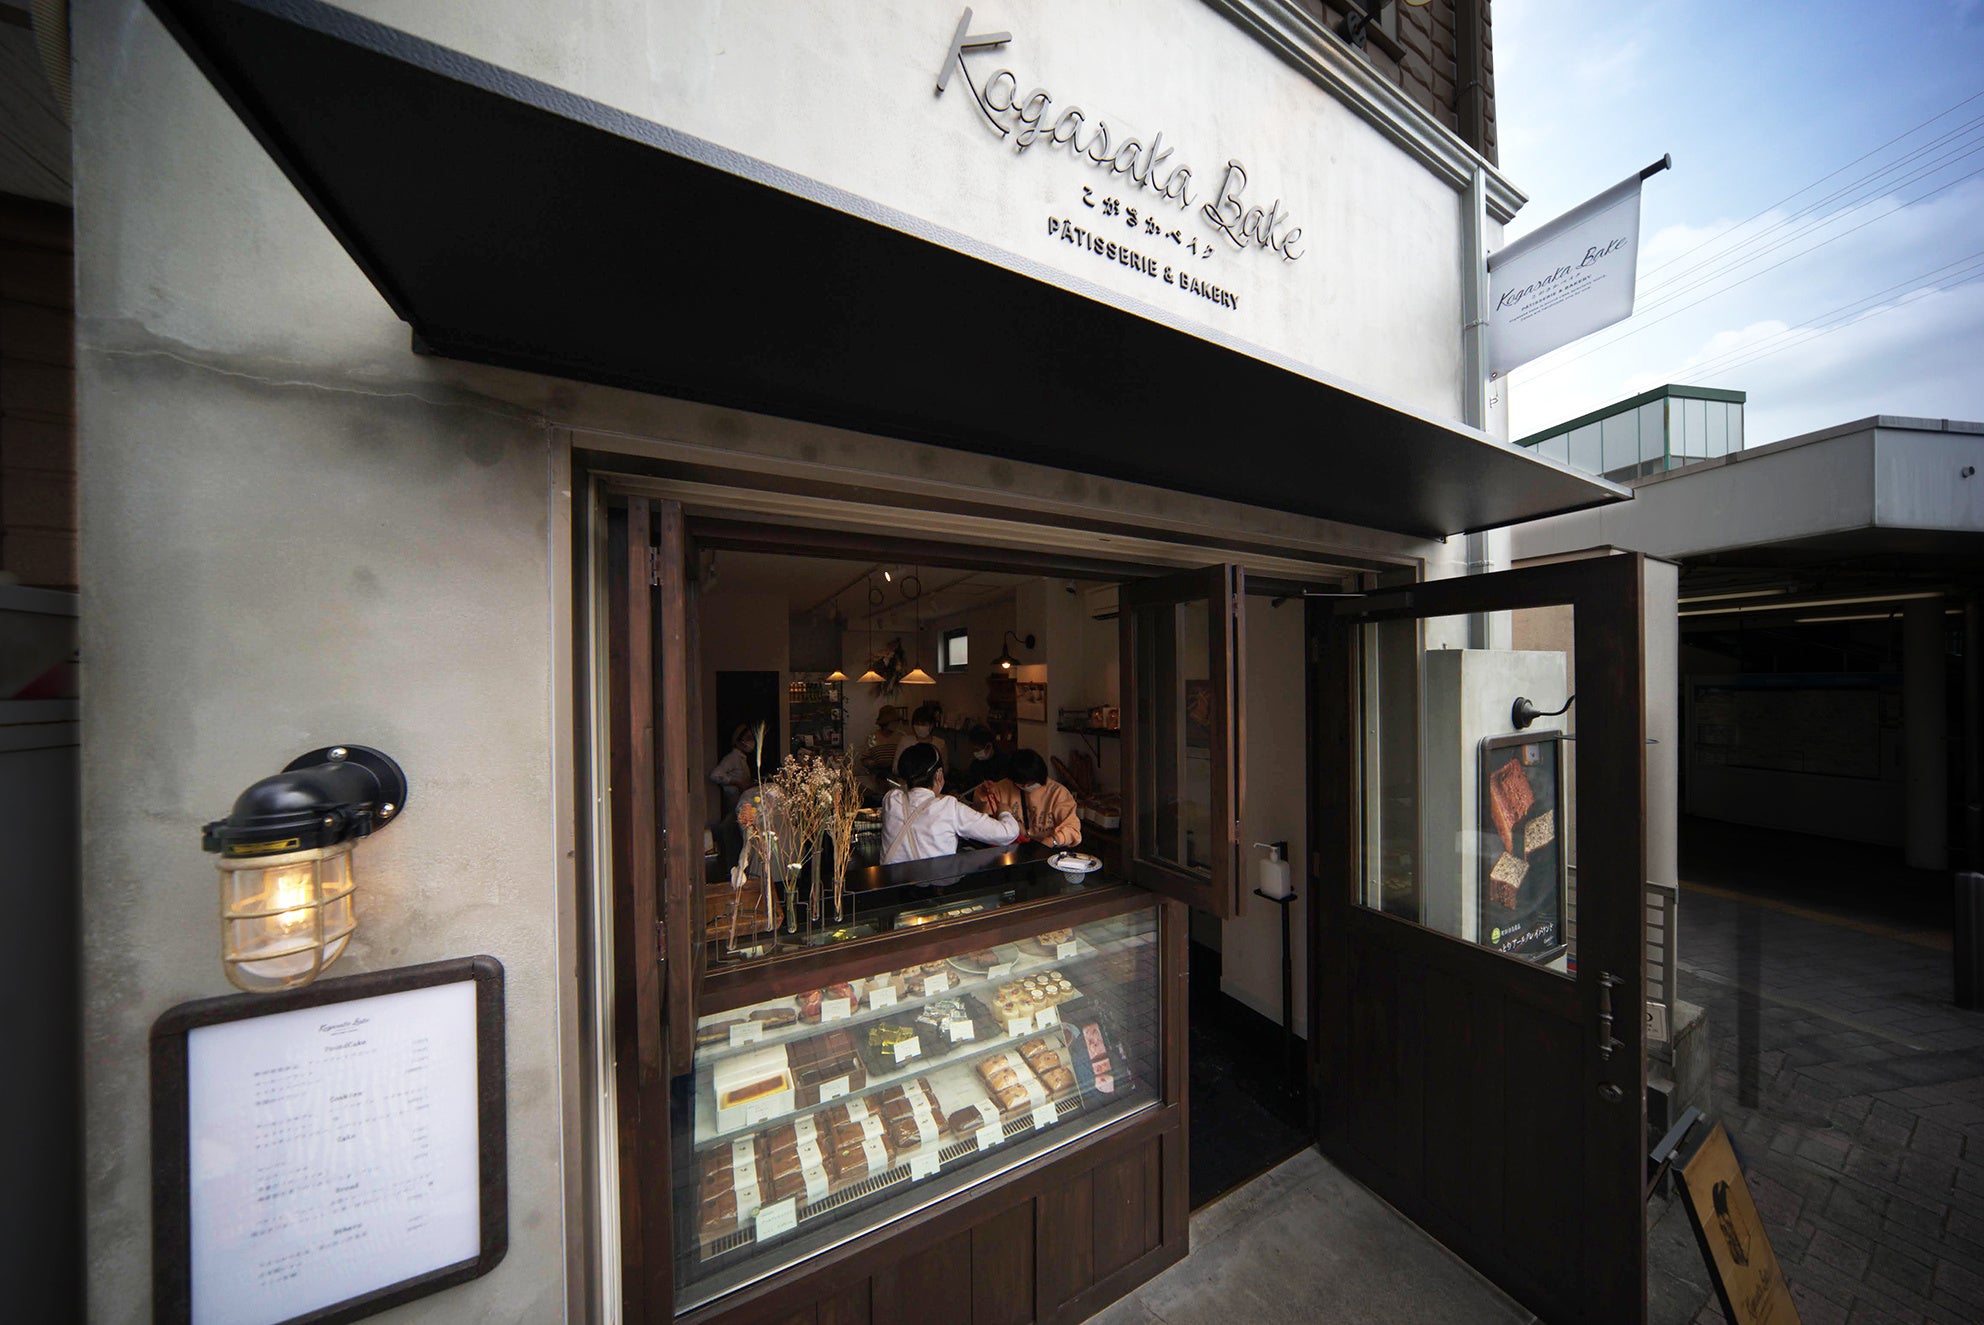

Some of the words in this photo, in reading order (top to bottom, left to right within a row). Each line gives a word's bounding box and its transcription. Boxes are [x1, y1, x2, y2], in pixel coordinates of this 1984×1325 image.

[935, 6, 1198, 211] Kogasaka
[1200, 158, 1306, 262] Bake
[1163, 265, 1174, 284] &
[1179, 271, 1240, 311] BAKERY
[1495, 263, 1573, 312] Kogasaka
[1575, 236, 1628, 269] Bake
